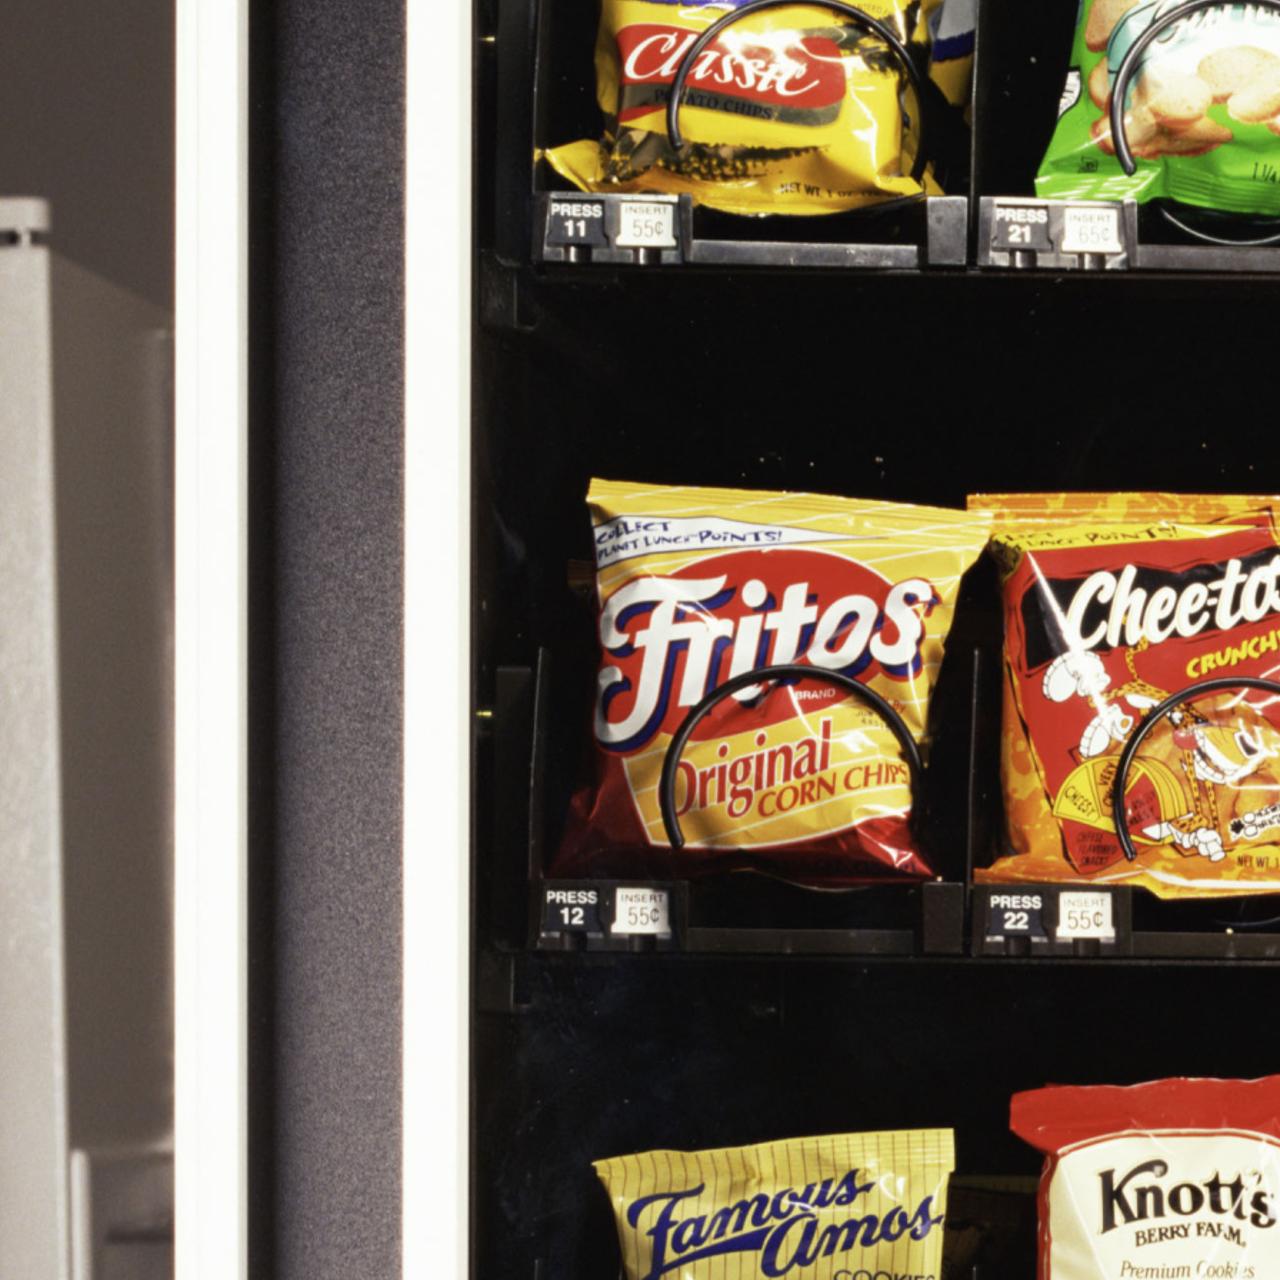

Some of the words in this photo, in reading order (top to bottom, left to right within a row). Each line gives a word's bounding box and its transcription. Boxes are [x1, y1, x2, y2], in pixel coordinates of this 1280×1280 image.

[624, 34, 820, 96] Classic
[551, 203, 602, 219] PRESS
[565, 220, 586, 238] 11
[594, 574, 936, 747] Fritos
[675, 720, 832, 818] Original
[757, 776, 837, 817] CORN
[844, 763, 909, 790] CHIPS
[546, 891, 596, 903] PRESS
[560, 908, 584, 924] 12
[1097, 1159, 1276, 1234] Knott's
[760, 1194, 943, 1278] Amos
[1134, 1225, 1189, 1247] BERRY
[1120, 1262, 1191, 1279] Premium
